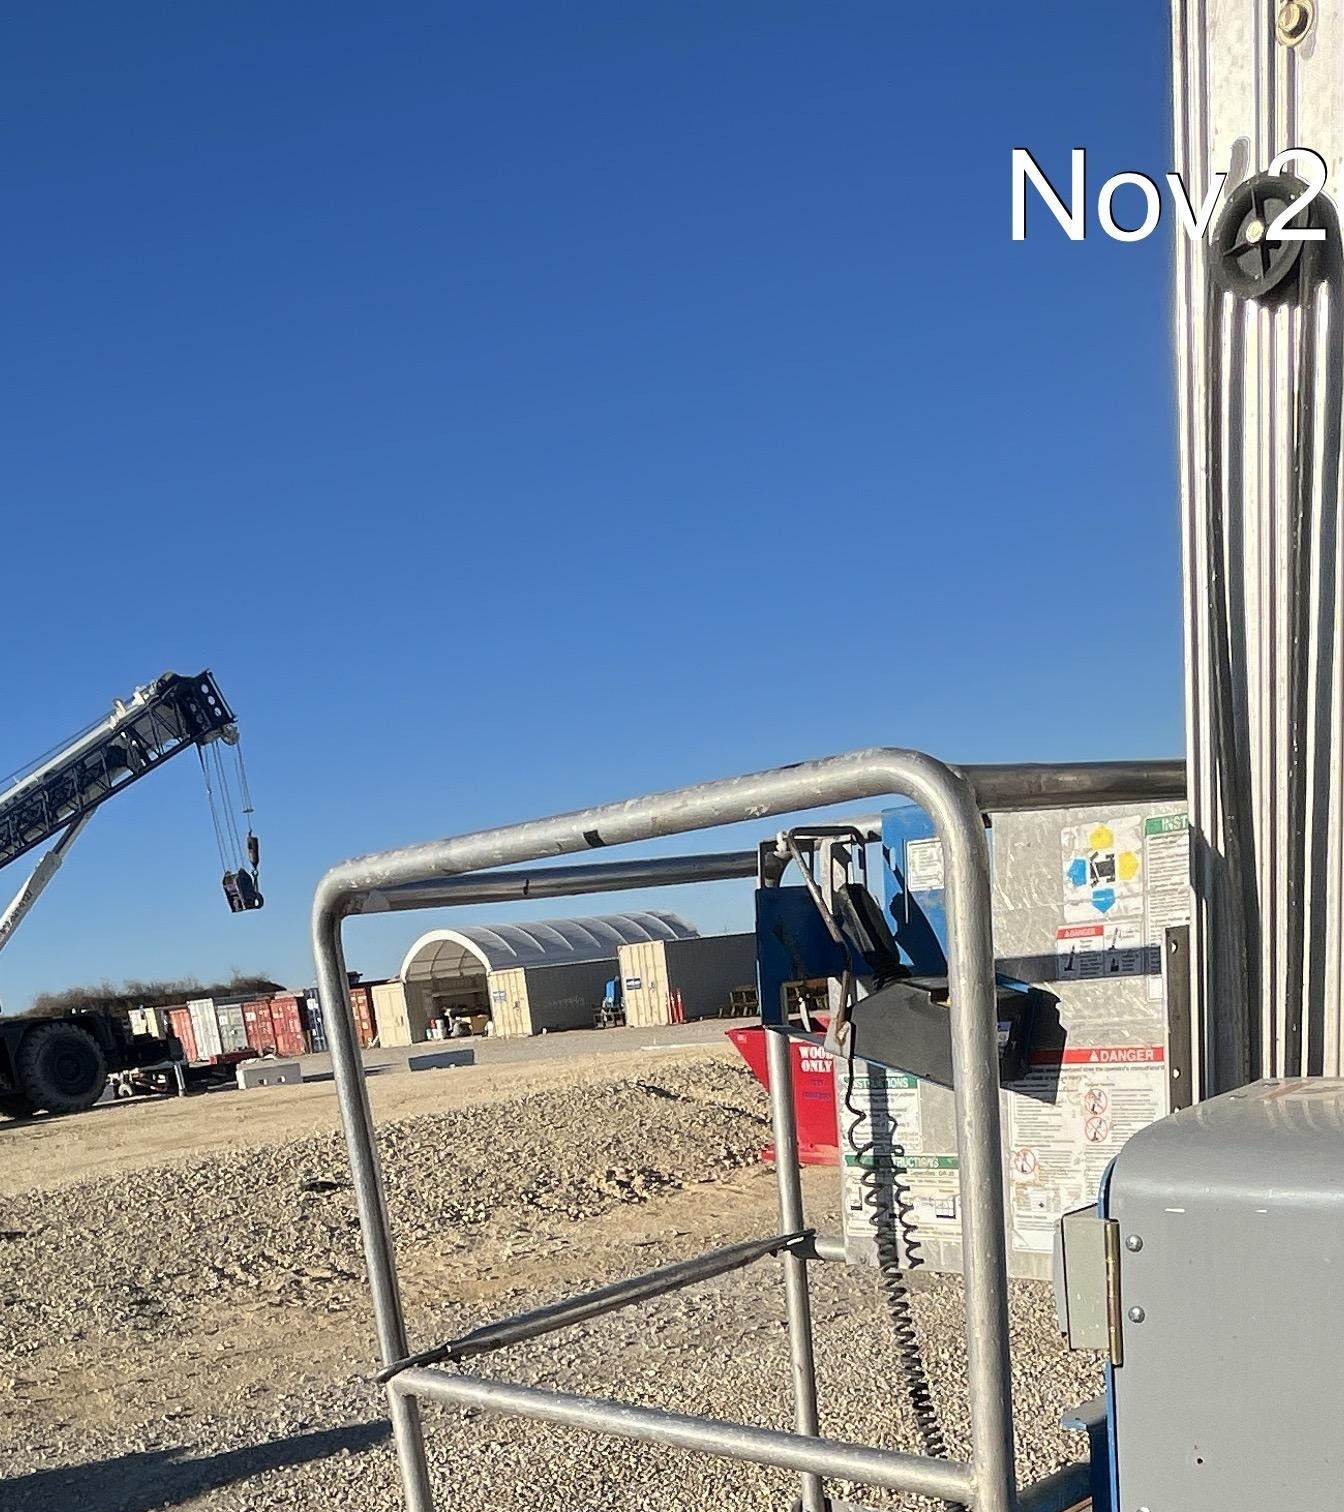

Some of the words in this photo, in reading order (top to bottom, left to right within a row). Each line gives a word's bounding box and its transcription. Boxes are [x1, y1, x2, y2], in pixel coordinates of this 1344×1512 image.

[1100, 1049, 1154, 1063] DANGER
[801, 1059, 833, 1073] ONLY
[850, 1077, 909, 1089] STRUIONS
